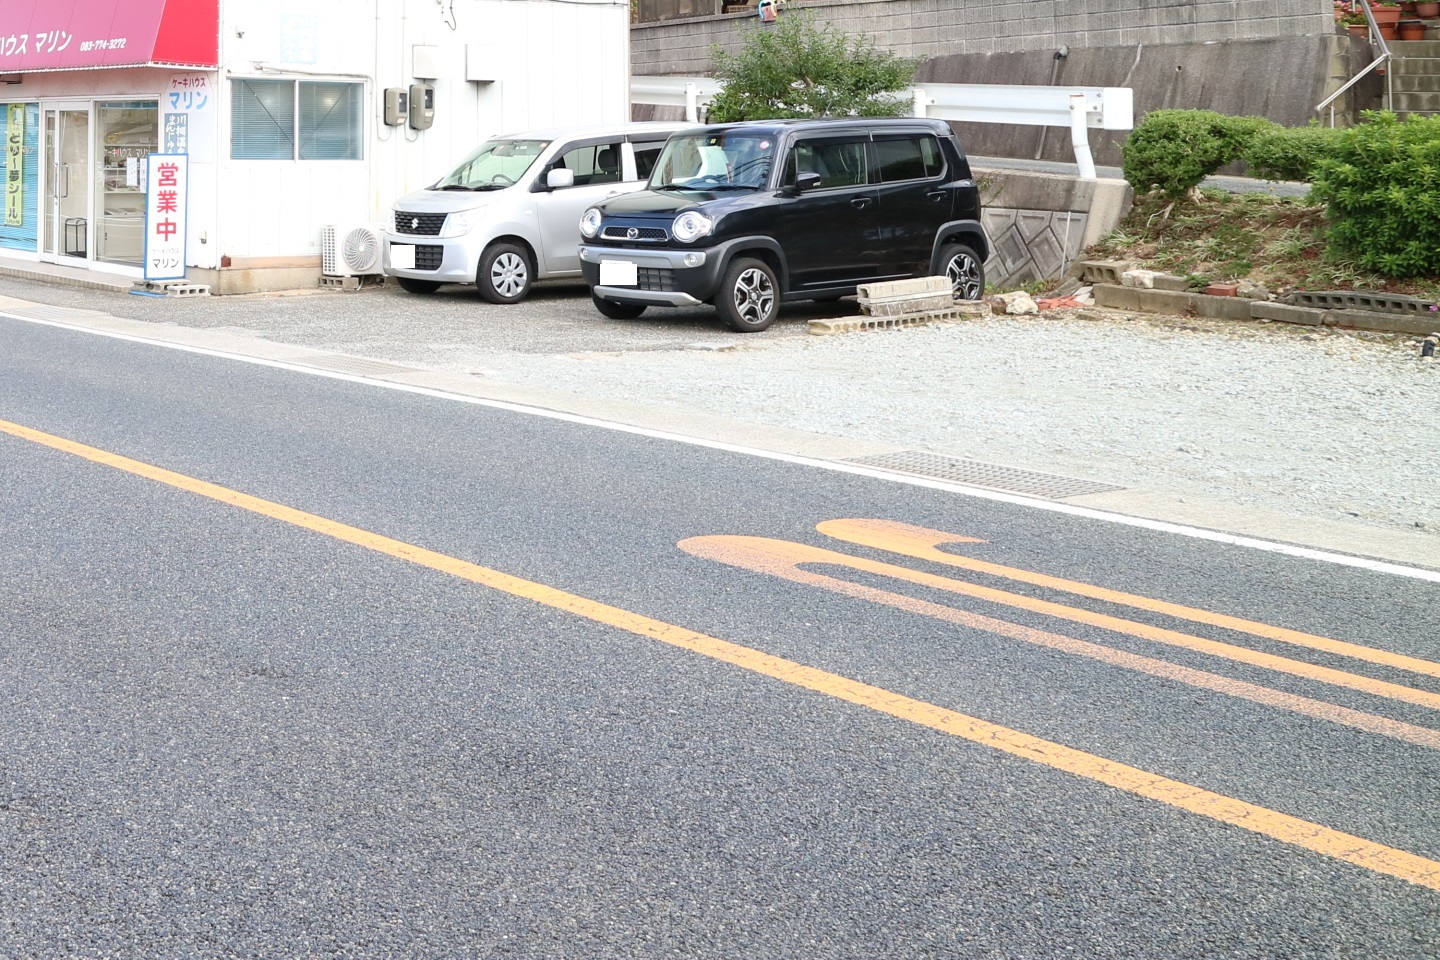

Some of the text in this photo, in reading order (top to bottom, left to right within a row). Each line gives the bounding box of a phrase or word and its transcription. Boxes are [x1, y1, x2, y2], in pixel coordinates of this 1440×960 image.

[34, 30, 73, 56] マリン
[79, 37, 127, 52] 083-774-3272
[172, 77, 206, 88] ケーキハウス
[168, 91, 208, 110] マリン
[156, 162, 179, 242] 営業中
[152, 258, 179, 269] マリン
